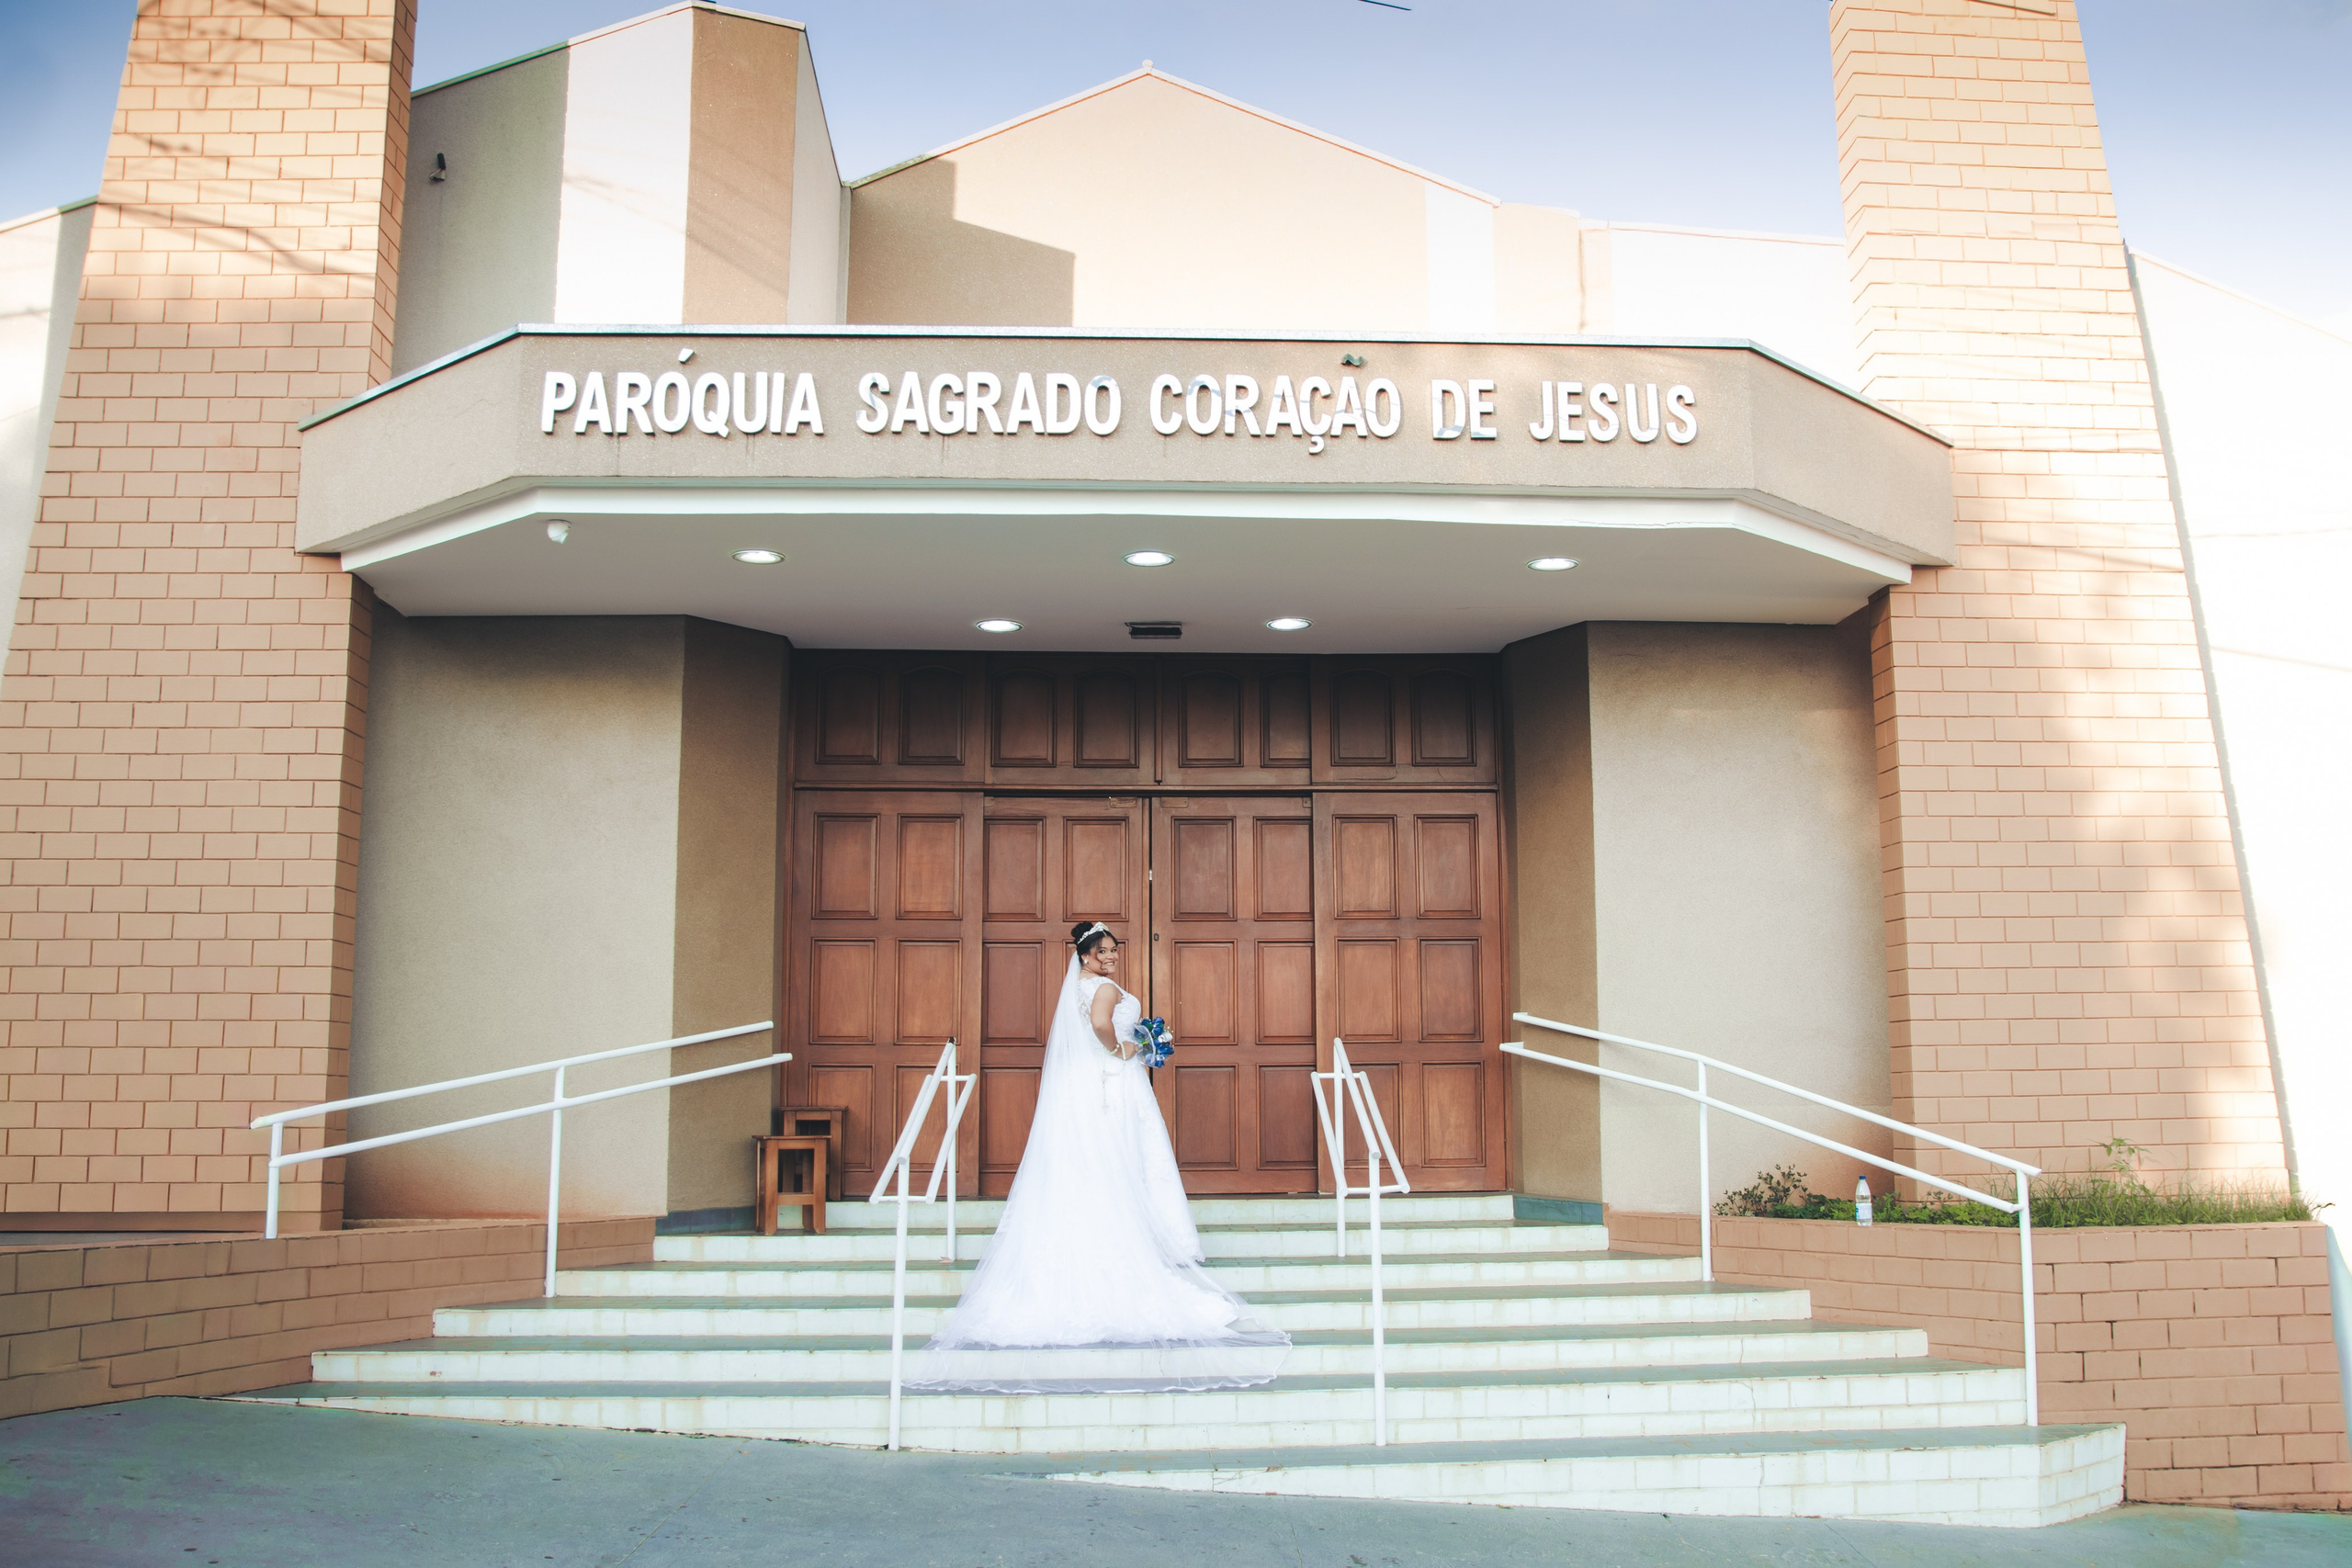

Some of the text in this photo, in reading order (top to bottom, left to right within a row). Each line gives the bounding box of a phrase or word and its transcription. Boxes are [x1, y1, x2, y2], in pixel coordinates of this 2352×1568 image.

[540, 347, 1699, 455] PARÓQUIA SAGRADO CORAÇÃO DE JESUS
